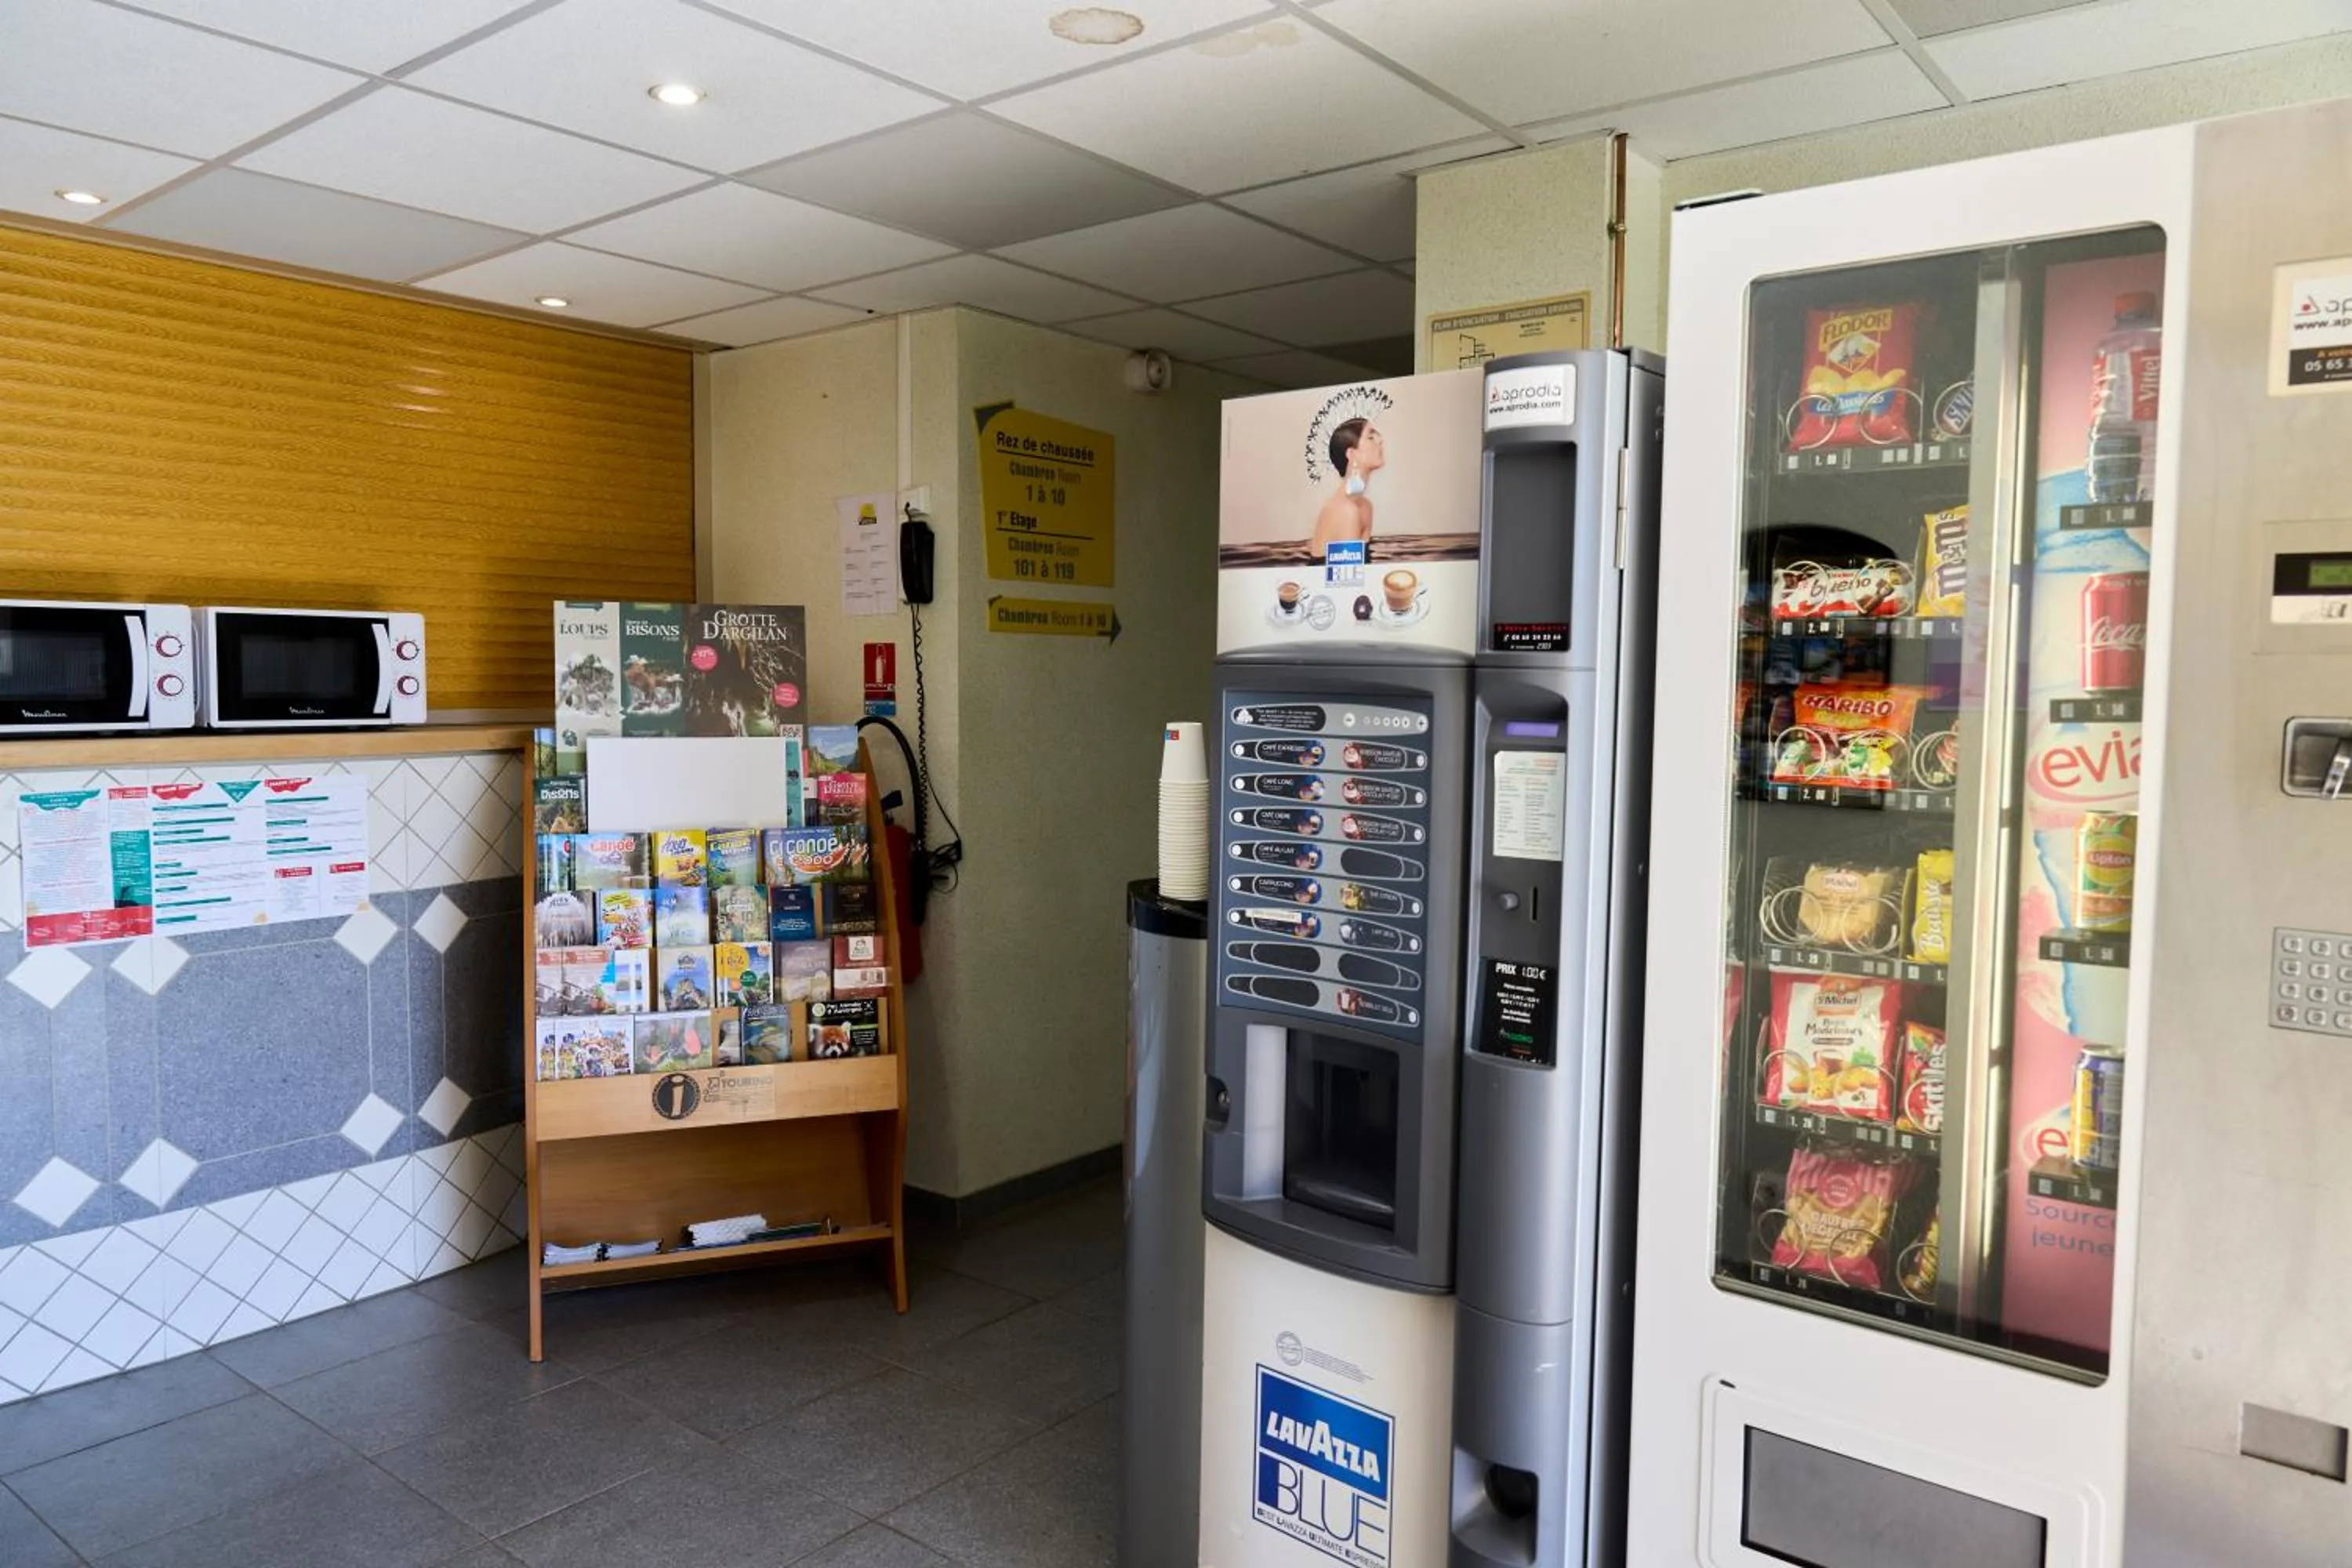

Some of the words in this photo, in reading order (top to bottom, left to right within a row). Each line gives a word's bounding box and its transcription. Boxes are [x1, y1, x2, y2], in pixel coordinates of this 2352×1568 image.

[1823, 313, 1889, 344] FLODOR
[1501, 383, 1561, 401] aprodia
[996, 431, 1018, 449] Rez
[1023, 437, 1038, 452] de
[1040, 441, 1095, 462] chaussée
[1010, 461, 1055, 481] Chambres
[1025, 484, 1033, 502] 1
[1038, 485, 1047, 503] à
[1051, 488, 1066, 506] 10
[1007, 536, 1054, 555] Chambres
[1014, 559, 1036, 577] 101
[1041, 560, 1049, 578] à
[1054, 562, 1075, 580] 119
[714, 609, 778, 626] GROTTE
[998, 608, 1048, 626] Chambres
[626, 625, 681, 636] BISONS
[702, 620, 788, 641] DARGILAN
[1805, 694, 1894, 717] HARIBO
[2090, 851, 2132, 866] Lipton
[1495, 962, 1517, 975] PRIX
[1266, 1410, 1381, 1483] LAVAZZA
[1258, 1451, 1387, 1560] BLUE
[1276, 1515, 1308, 1537] LAVAZZA
[1308, 1531, 1343, 1555] ULTIMATE
